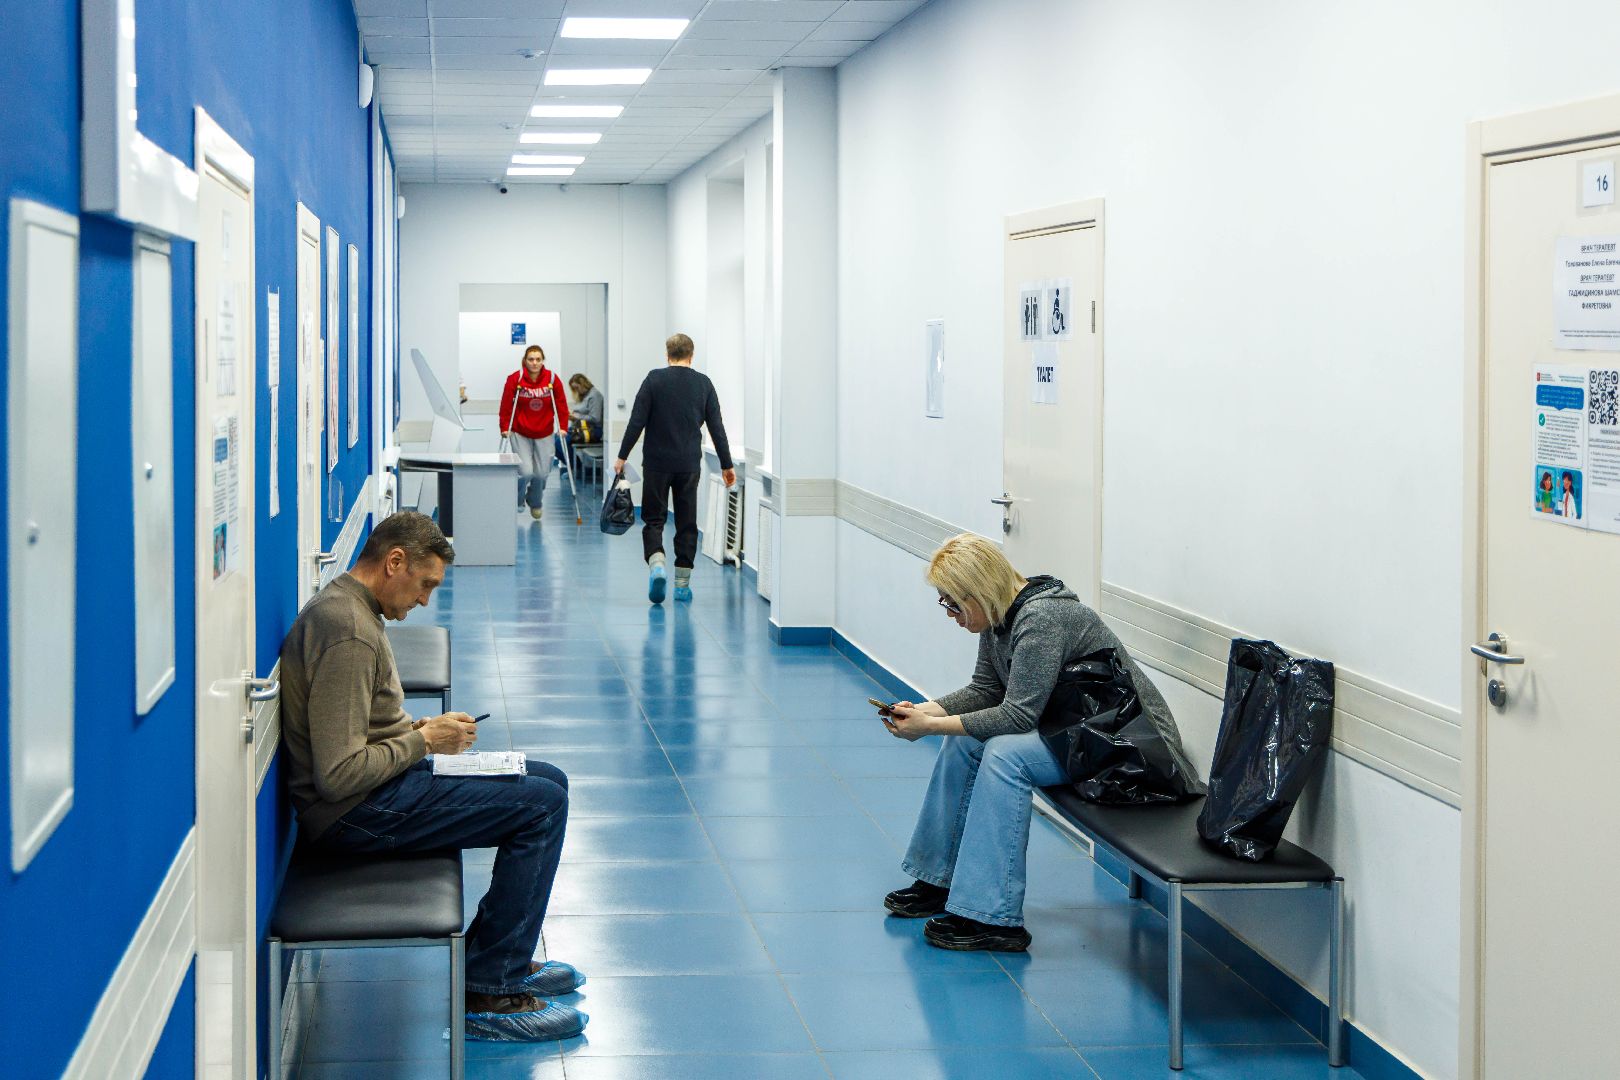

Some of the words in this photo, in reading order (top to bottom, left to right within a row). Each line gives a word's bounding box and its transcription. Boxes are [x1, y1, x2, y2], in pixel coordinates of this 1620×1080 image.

[1597, 174, 1608, 191] 16
[1581, 302, 1612, 310] ФИКРЕТОВНА
[1036, 366, 1054, 383] ТУАЛЕТ
